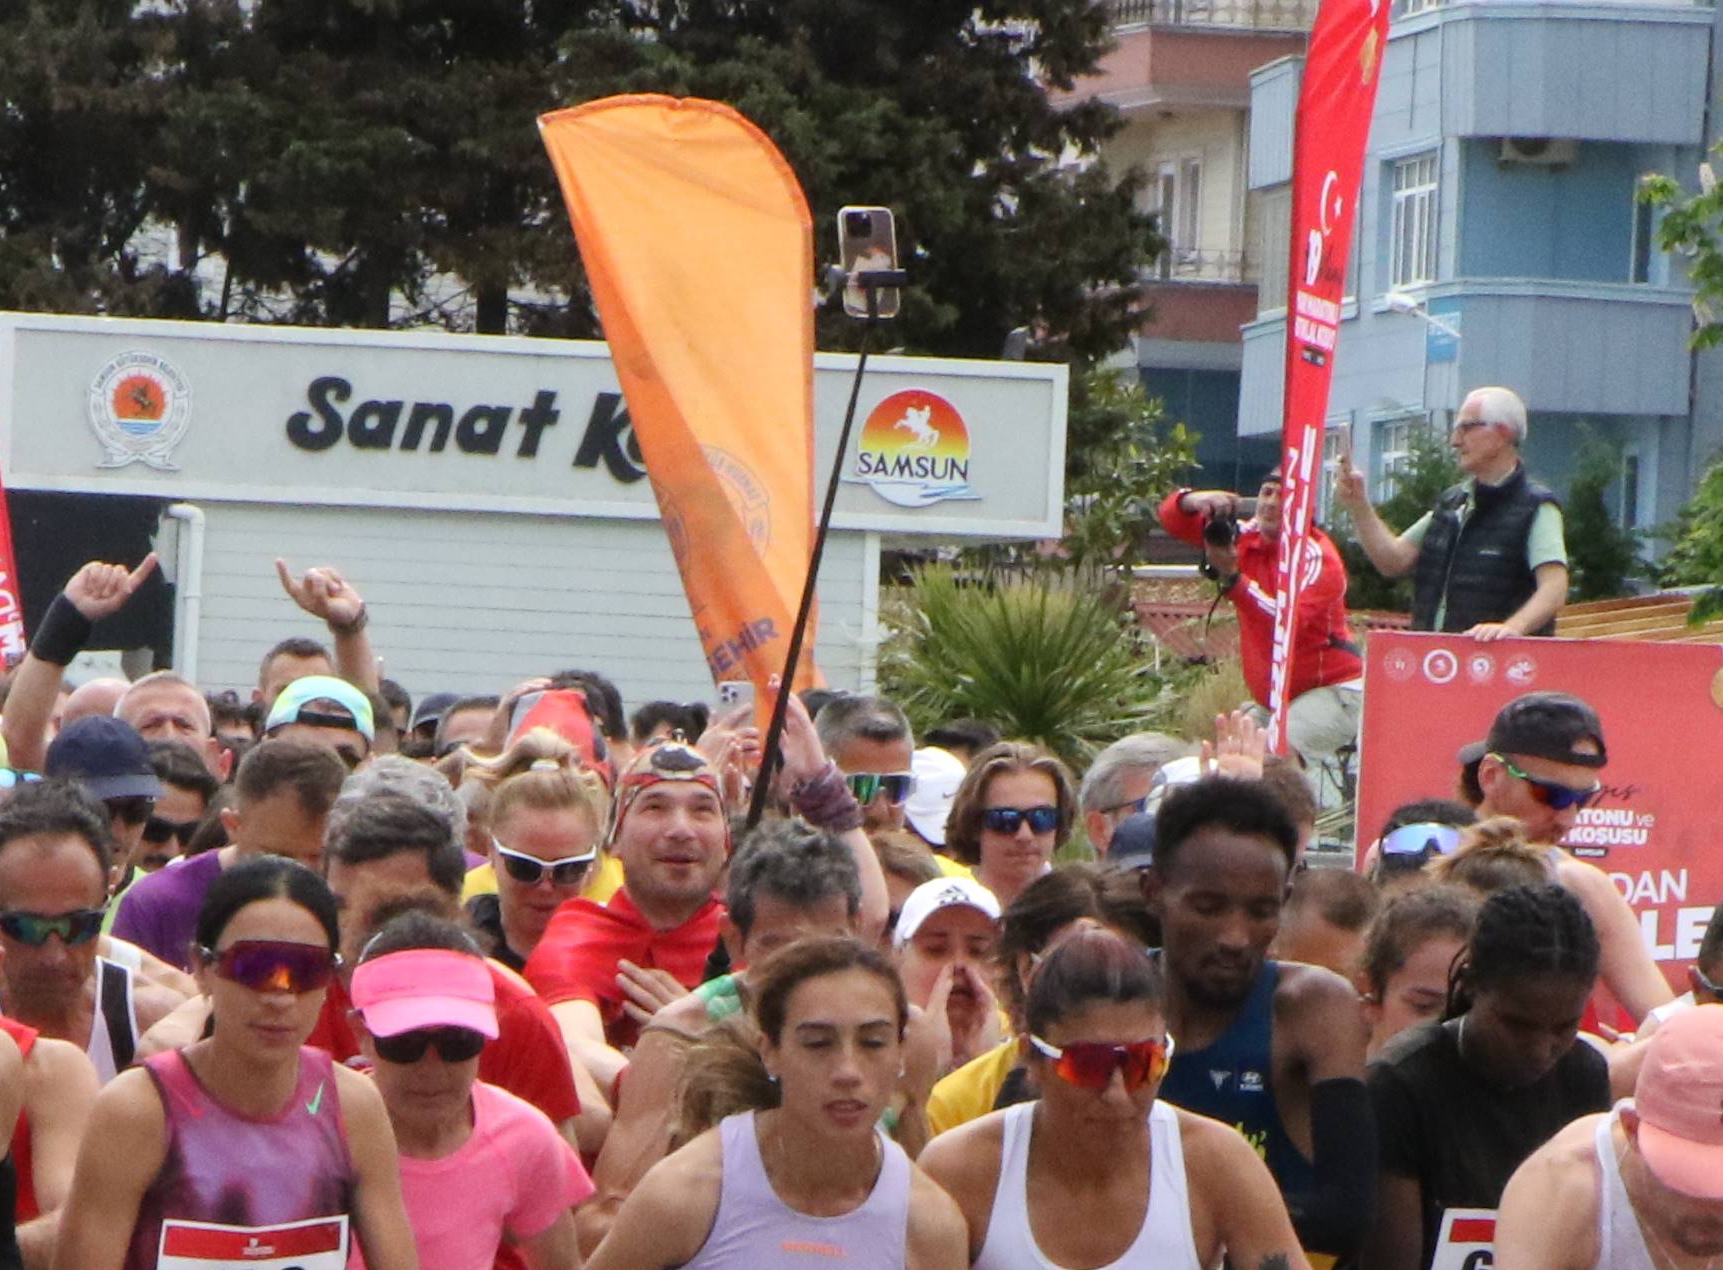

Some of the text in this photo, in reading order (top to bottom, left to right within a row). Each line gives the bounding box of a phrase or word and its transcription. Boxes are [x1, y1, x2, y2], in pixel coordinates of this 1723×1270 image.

[286, 376, 560, 458] Sanat
[858, 451, 969, 482] SAMSUN
[1573, 808, 1655, 827] ATONU ve
[1569, 827, 1649, 847] KOŞUSU
[1608, 868, 1688, 906] DAN
[1640, 906, 1716, 961] LE
